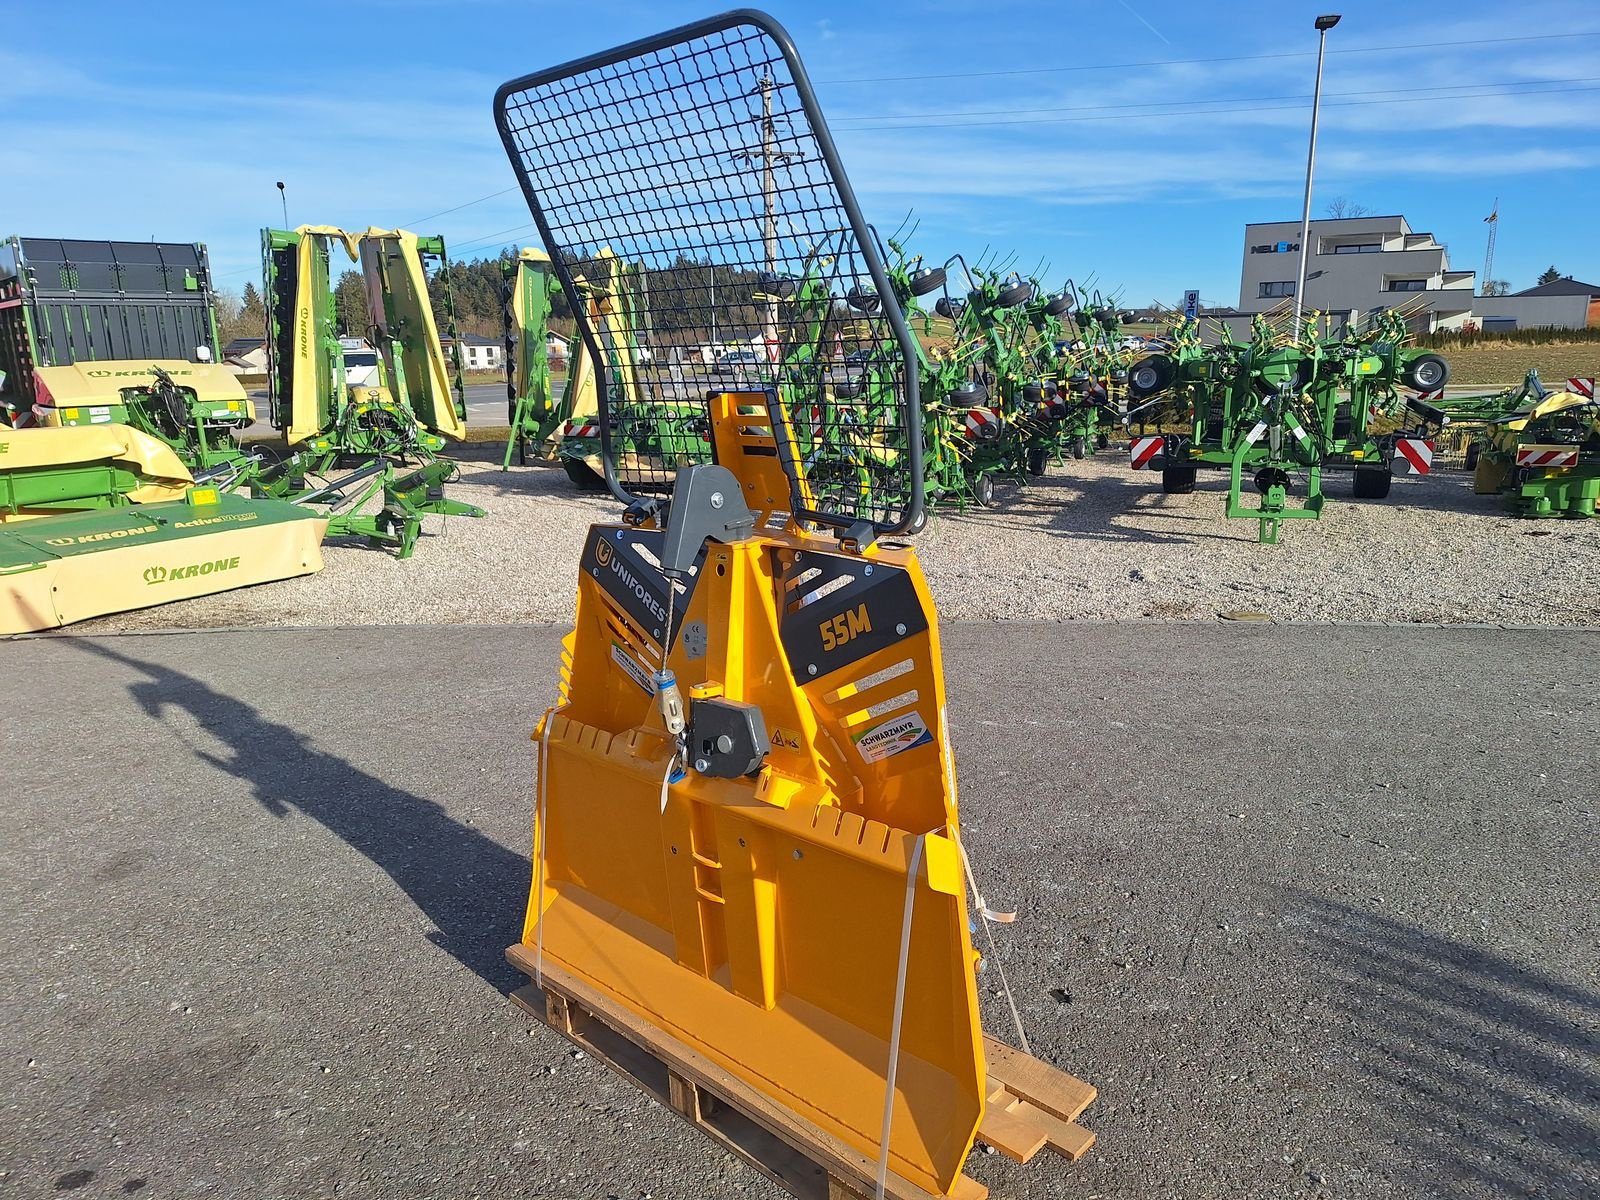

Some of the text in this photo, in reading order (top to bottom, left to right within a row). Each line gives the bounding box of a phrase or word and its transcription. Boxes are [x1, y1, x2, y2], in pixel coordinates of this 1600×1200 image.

[78, 525, 158, 544] KRONE
[169, 556, 240, 581] KRONE
[819, 603, 872, 652] 55M
[861, 721, 914, 747] SCHWARZMAYR
